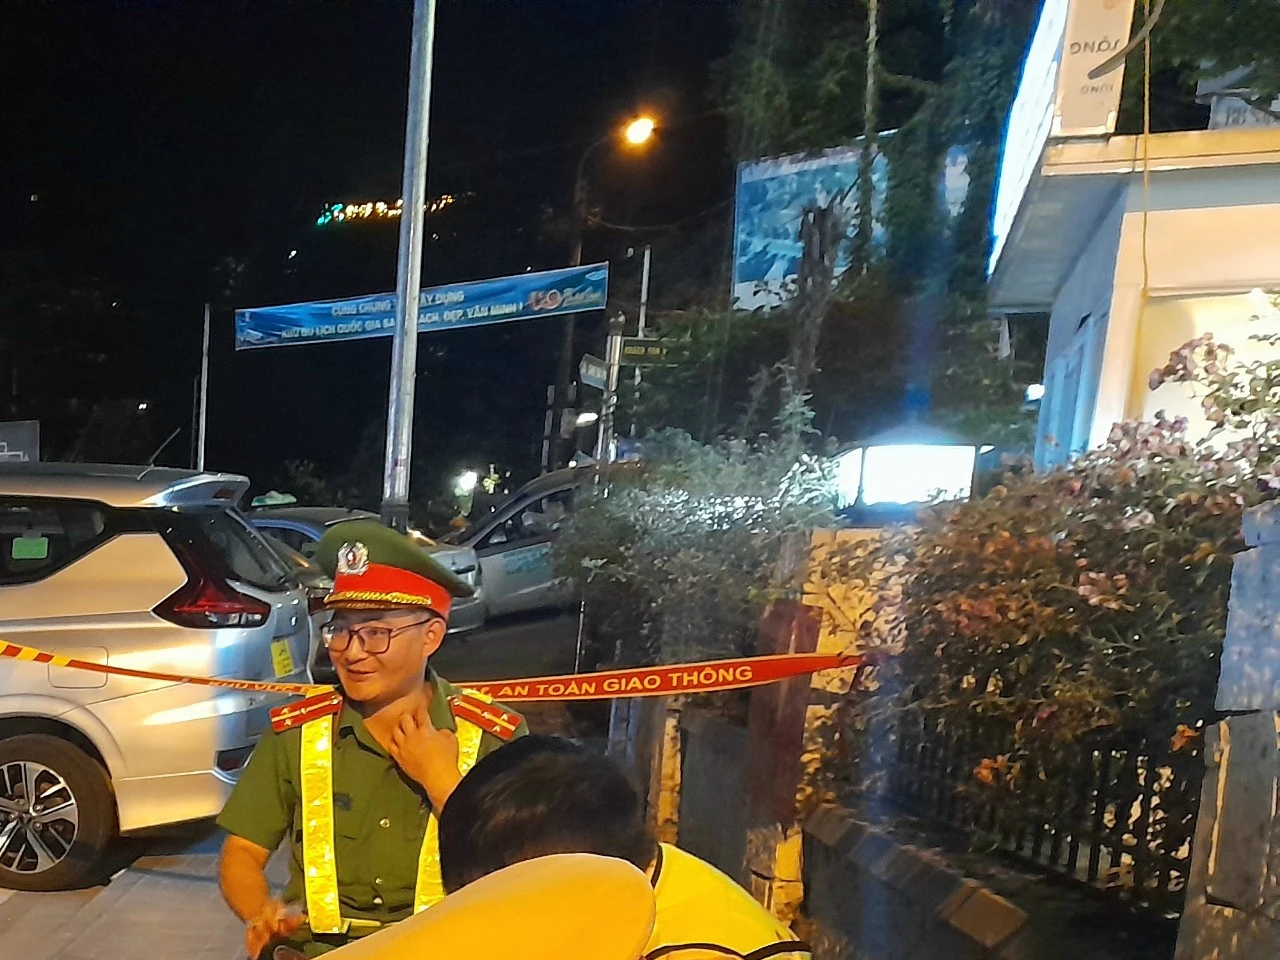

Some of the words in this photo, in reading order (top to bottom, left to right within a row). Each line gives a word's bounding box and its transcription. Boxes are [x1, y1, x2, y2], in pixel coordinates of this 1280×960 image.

[316, 324, 337, 337] LỊCH
[337, 319, 363, 333] QUỐC
[364, 319, 381, 330] GIA
[498, 683, 529, 697] AN
[535, 678, 597, 697] TOÀN
[603, 675, 662, 693] GIAO
[666, 664, 754, 689] THÔNG
